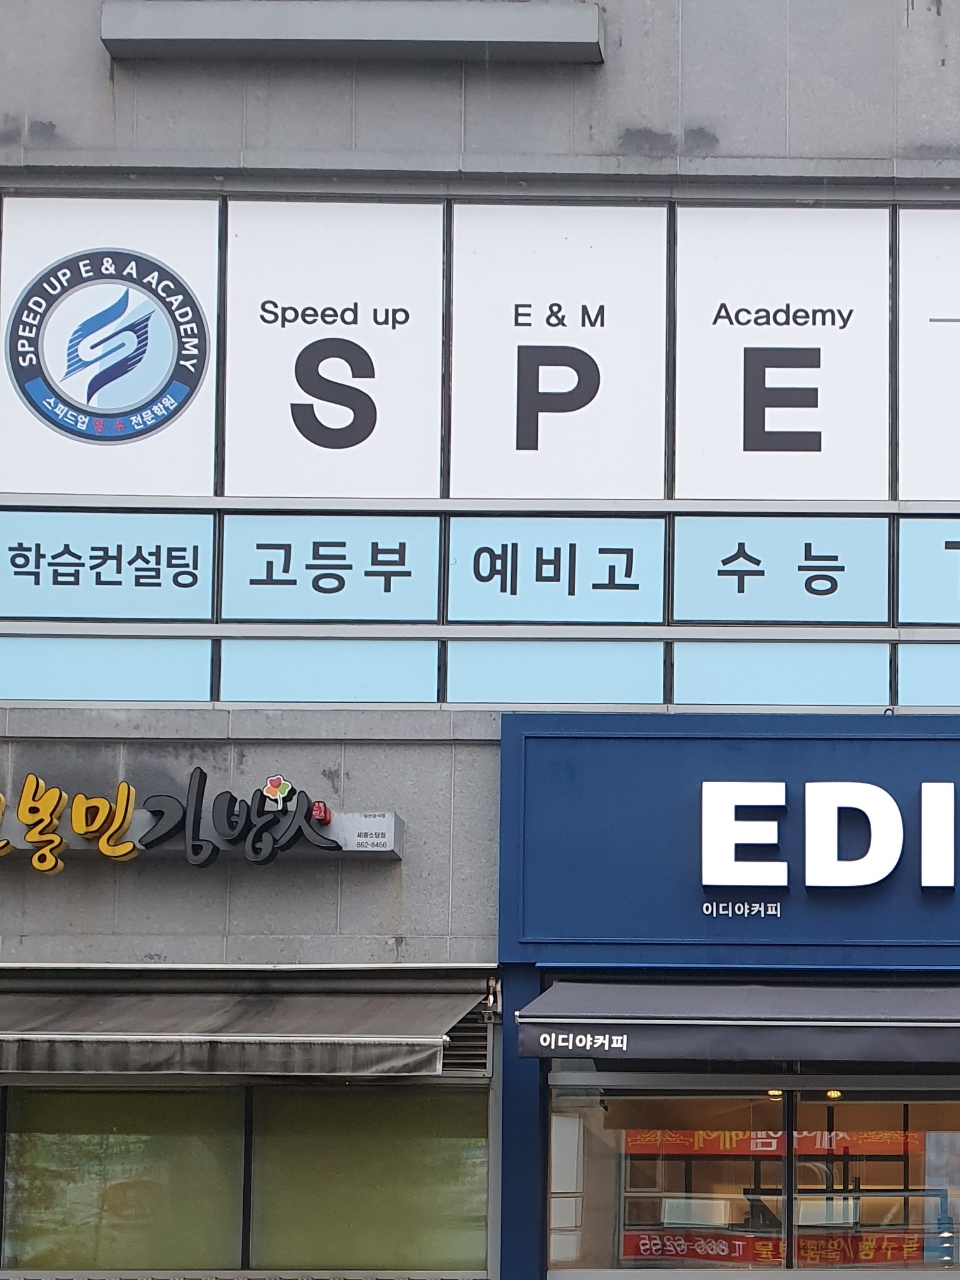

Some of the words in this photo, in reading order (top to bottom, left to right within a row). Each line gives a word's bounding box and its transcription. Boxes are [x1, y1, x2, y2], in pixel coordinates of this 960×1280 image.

[17, 296, 47, 368] SPEED
[43, 268, 71, 295] UP
[79, 260, 94, 278] E
[101, 257, 116, 274] &
[123, 261, 138, 278] A
[143, 271, 199, 373] ACADEMY
[259, 301, 358, 329] Speed
[373, 306, 409, 329] up
[514, 304, 532, 327] E
[545, 303, 567, 328] &
[581, 304, 606, 328] M
[712, 303, 854, 329] Academy
[42, 397, 89, 430] 스피드업
[130, 394, 177, 429] 전문학원
[8, 542, 200, 588] 학습컨설팅
[249, 541, 412, 594] 고등부
[473, 543, 640, 596] 예비고
[702, 901, 781, 918] 이디야커피
[539, 1033, 629, 1052] 이디야커피
